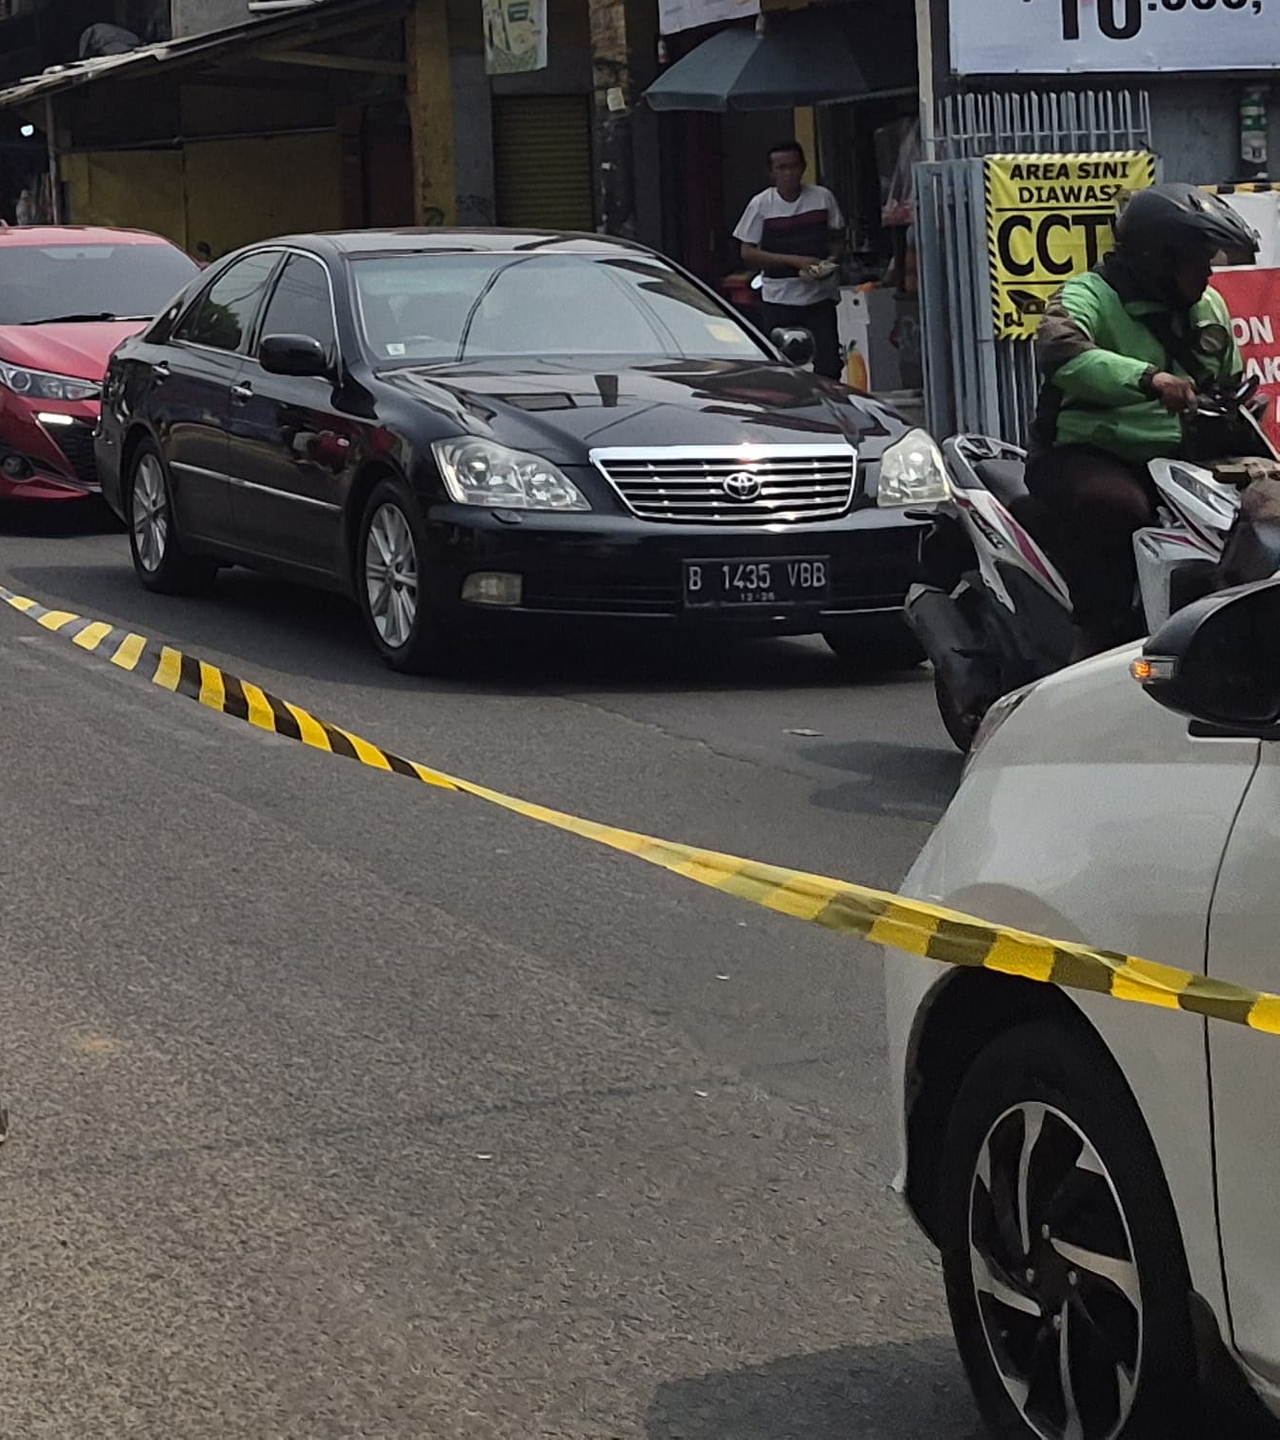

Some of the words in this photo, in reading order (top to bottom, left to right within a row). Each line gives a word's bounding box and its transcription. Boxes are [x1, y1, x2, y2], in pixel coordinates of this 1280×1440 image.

[1010, 162, 1070, 181] AREA
[1077, 161, 1129, 179] SINI
[997, 214, 1117, 277] CCT
[689, 566, 701, 590] B
[722, 564, 770, 590] 1435
[788, 562, 825, 587] VBB
